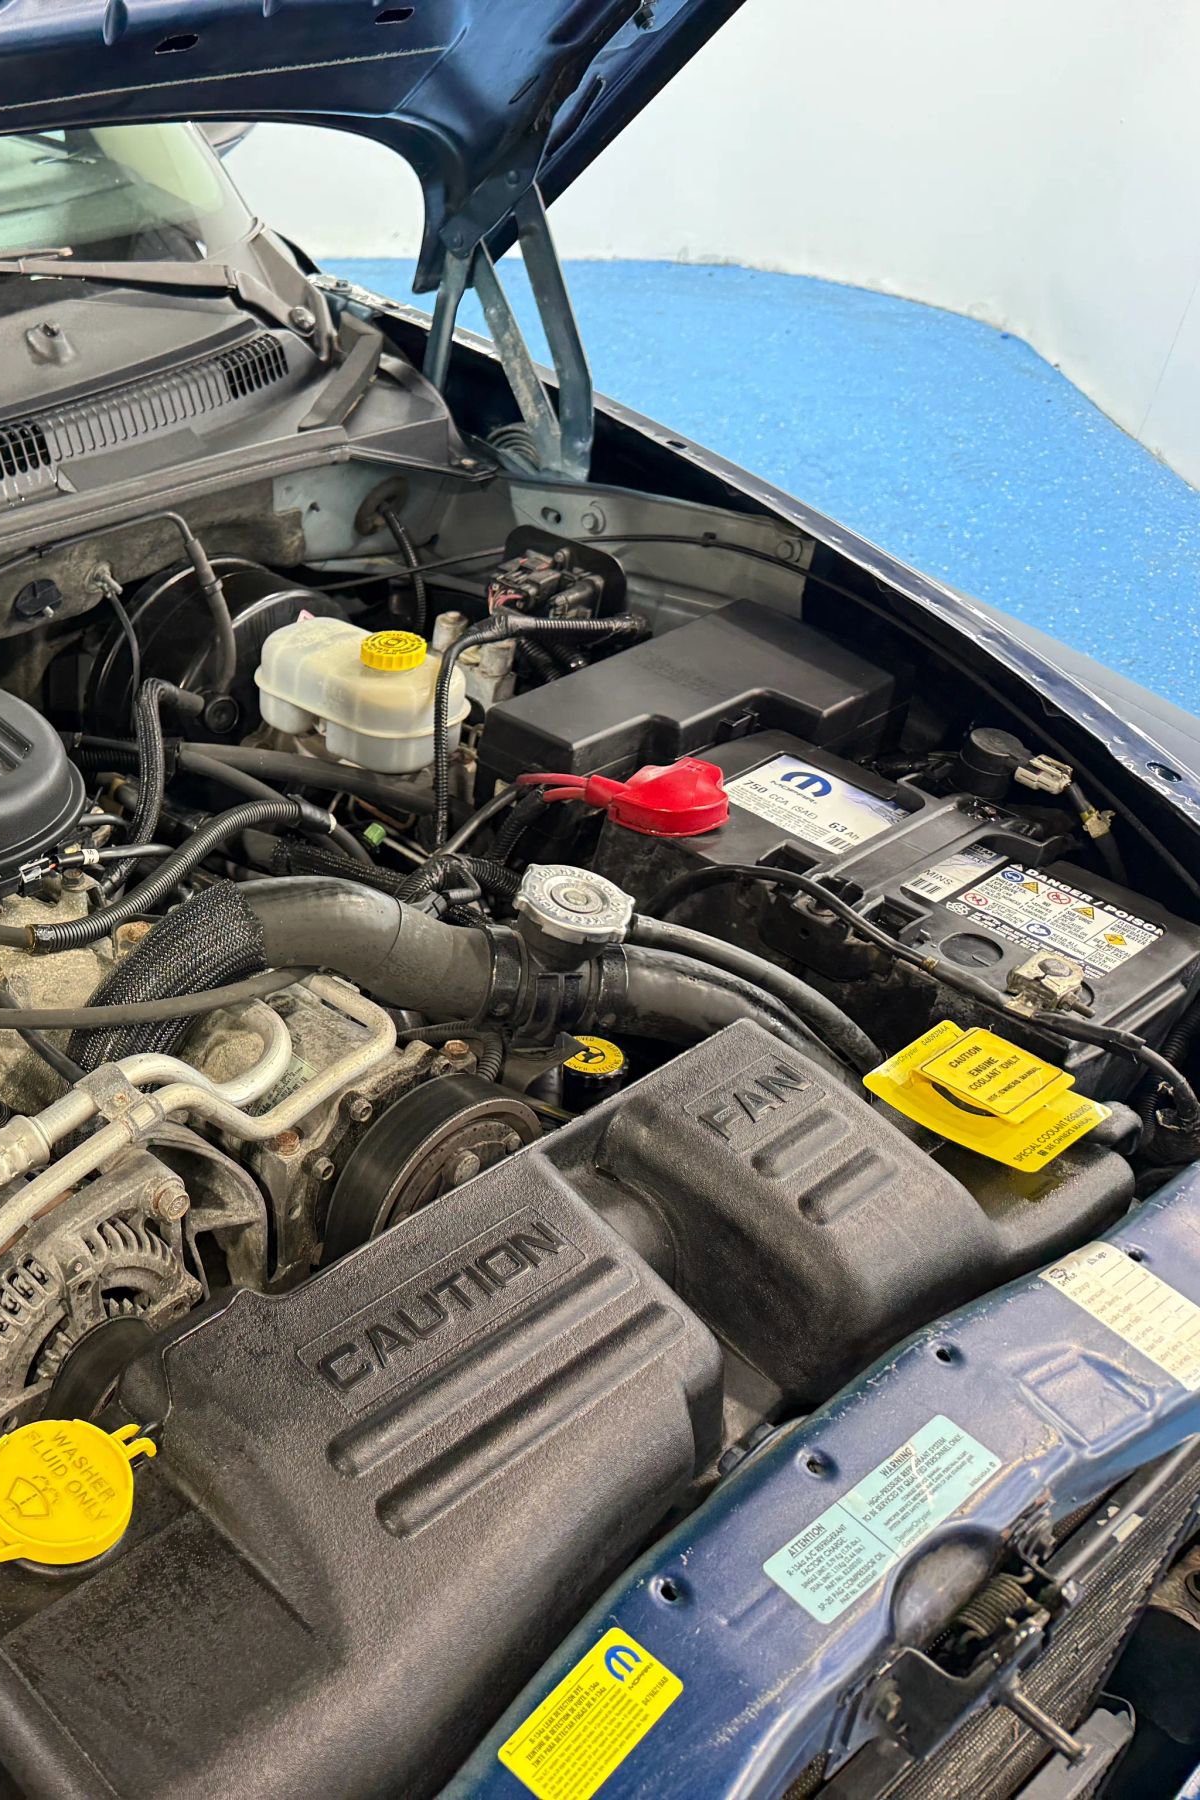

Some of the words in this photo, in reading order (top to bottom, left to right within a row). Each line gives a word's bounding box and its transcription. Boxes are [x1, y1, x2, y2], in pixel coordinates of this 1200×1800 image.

[742, 780, 767, 793] 750
[768, 793, 789, 804] CCA
[790, 805, 818, 820] (SAE)
[828, 821, 847, 833] 63
[844, 831, 860, 840] Ah
[1026, 868, 1091, 902] DANGER
[1092, 898, 1103, 907] /
[1052, 933, 1067, 942] READ
[1095, 943, 1110, 952] HELP
[1110, 951, 1125, 959] FAST
[1105, 944, 1131, 956] MEDICAL
[947, 1044, 983, 1069] CAUTION
[967, 1055, 999, 1077] ENGINE
[968, 1067, 1001, 1091] COOLANT
[1000, 1054, 1021, 1068] ONLY
[697, 1062, 812, 1140] FAN
[1013, 1141, 1040, 1161] SPECIAL
[1037, 1120, 1067, 1142] COOLANT
[1044, 1141, 1057, 1151] SEE
[317, 1221, 569, 1393] CAUTION
[23, 1433, 70, 1479] FLUID
[66, 1480, 112, 1521] ONLY
[52, 1429, 117, 1505] WASHER
[867, 1475, 902, 1506] HIGH-PRESSURE
[928, 1437, 946, 1452] SYSTEM
[879, 1447, 913, 1476] WARNING
[861, 1513, 872, 1523] TO
[868, 1508, 878, 1517] BE
[875, 1490, 898, 1510] SERVICED
[896, 1484, 906, 1492] BY
[925, 1444, 950, 1467] PERSONNEL
[786, 1523, 825, 1556] ATTENTION
[786, 1559, 805, 1576] R-134a
[803, 1549, 817, 1561] A/C
[814, 1524, 846, 1551] REFRIGERANT
[801, 1554, 825, 1575] FACTORY
[842, 1558, 876, 1589] COMPRESSOR
[542, 1716, 556, 1728] LEAK
[553, 1694, 575, 1717] DETECTION
[568, 1705, 577, 1714] DE
[542, 1741, 557, 1755] PARA
[554, 1720, 575, 1742] DETECTAR
[572, 1706, 588, 1721] FUGAS
[584, 1699, 594, 1708] DE
